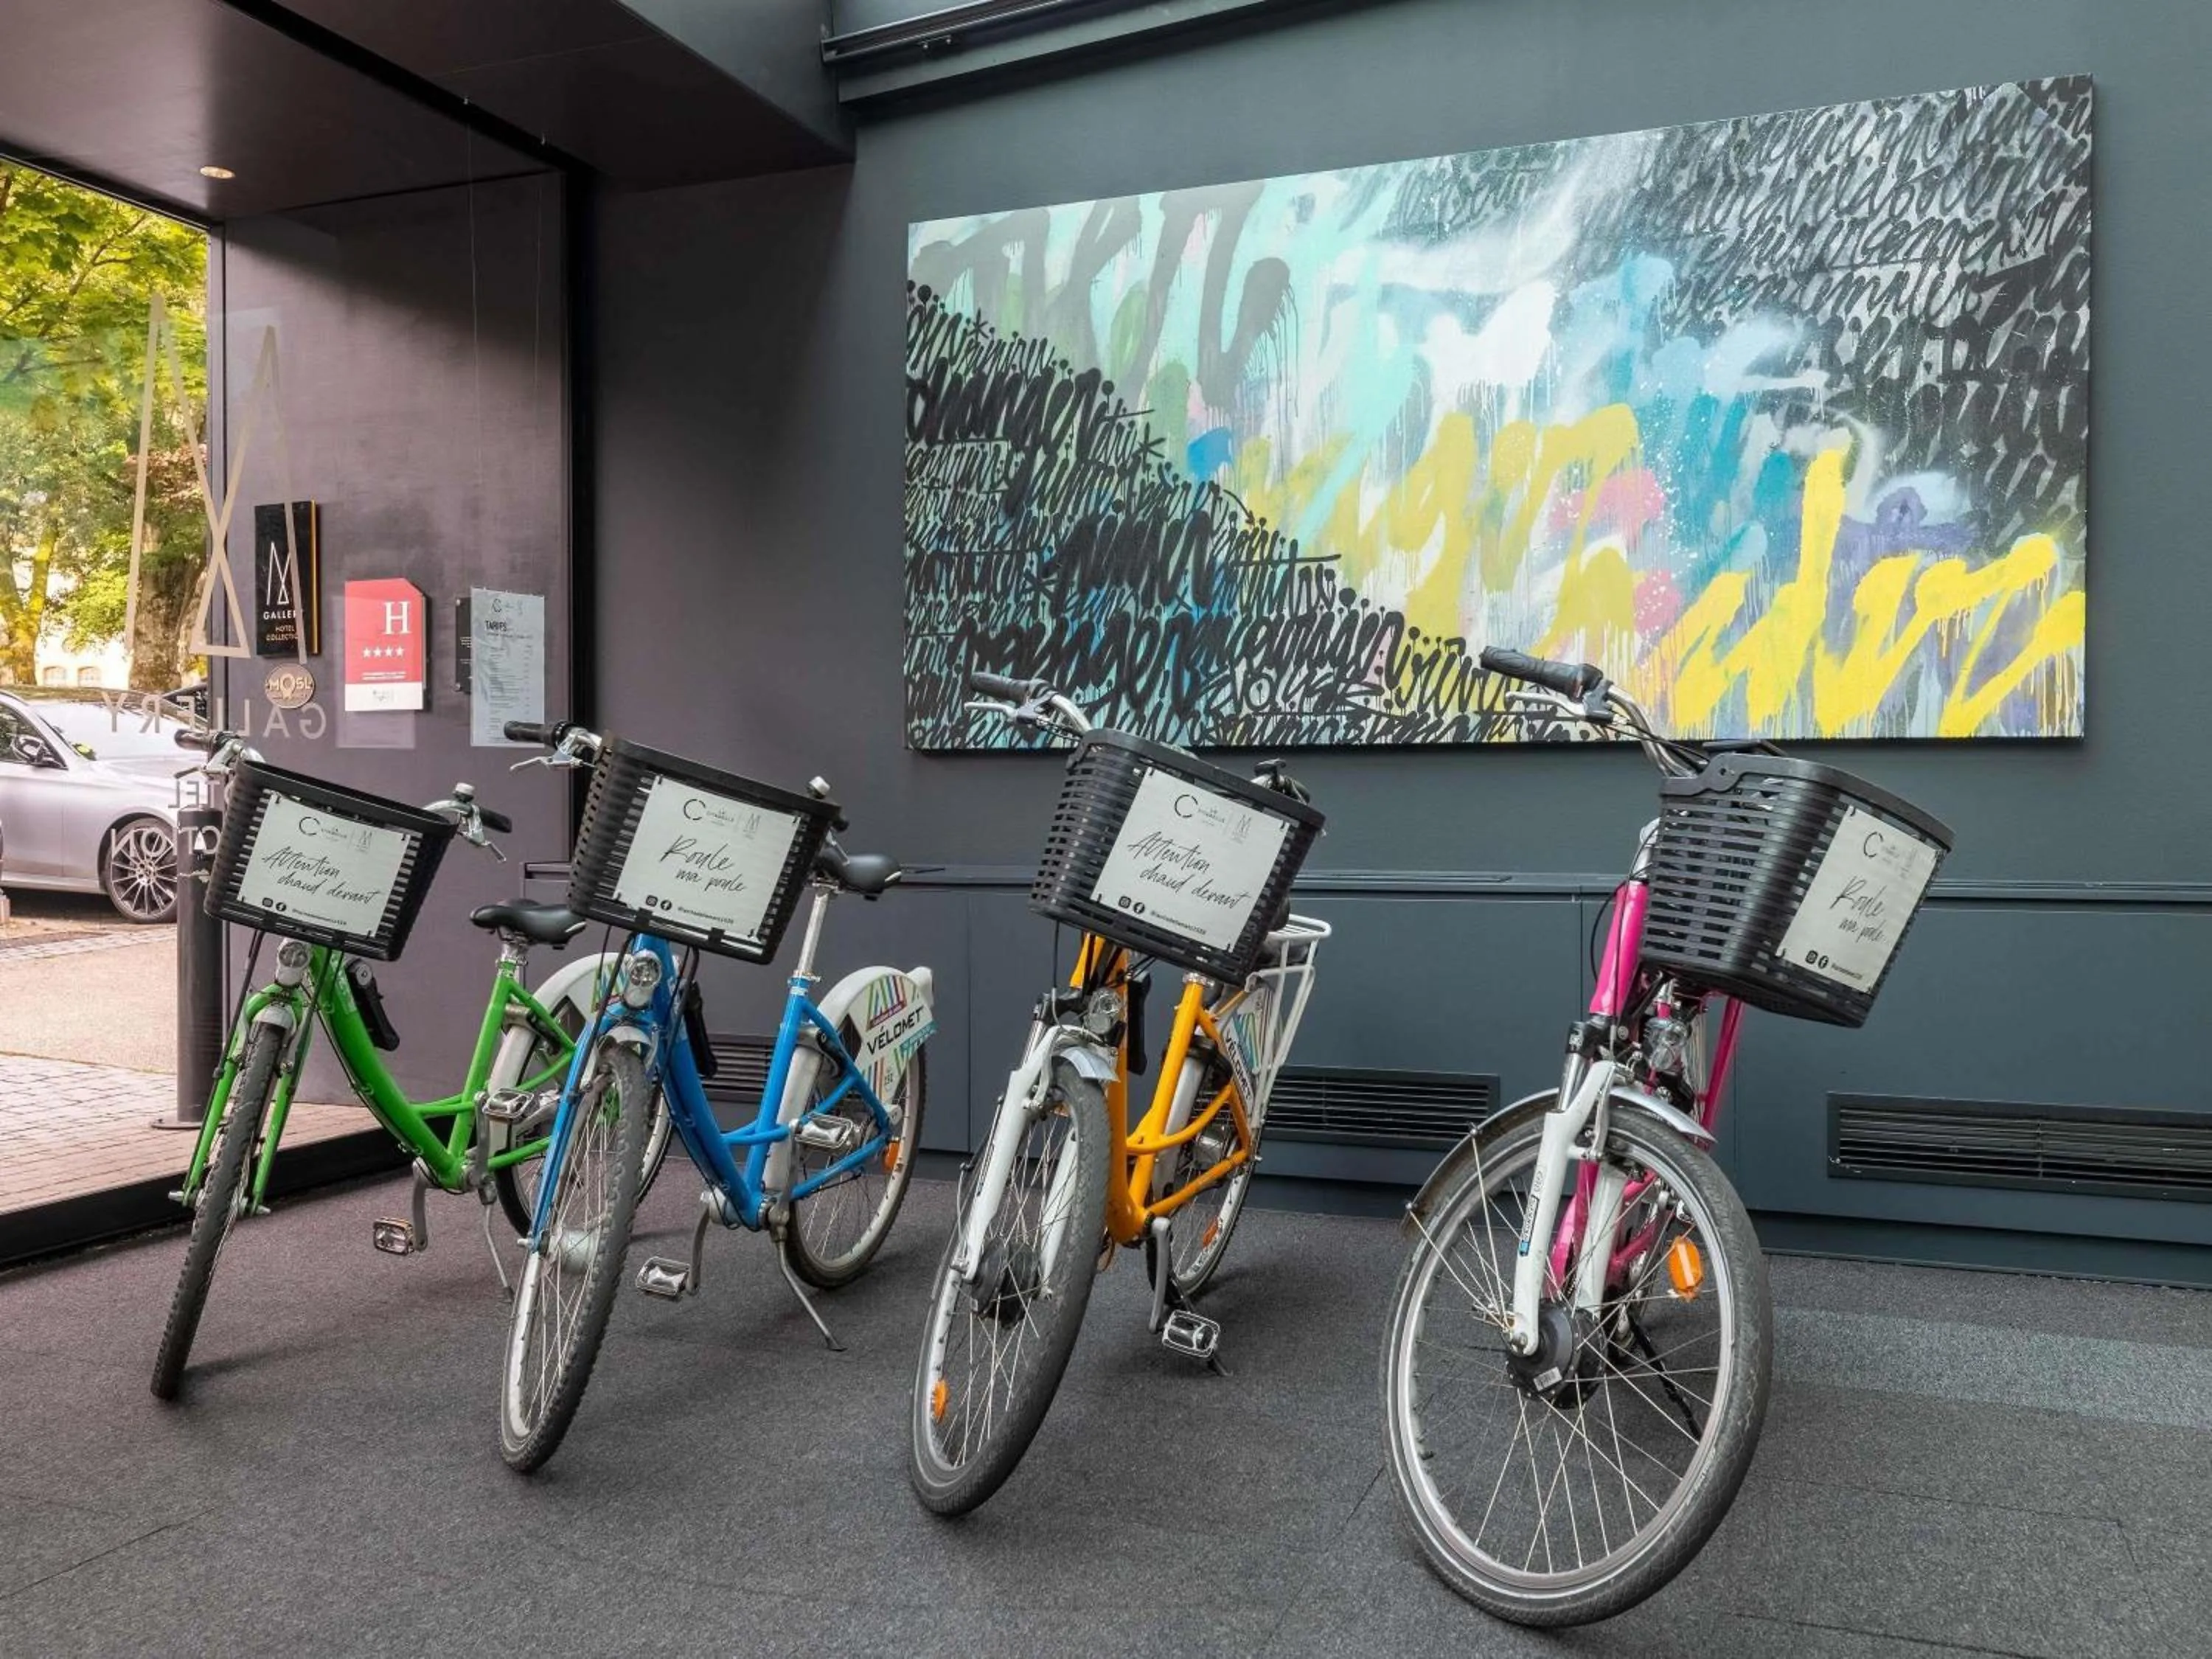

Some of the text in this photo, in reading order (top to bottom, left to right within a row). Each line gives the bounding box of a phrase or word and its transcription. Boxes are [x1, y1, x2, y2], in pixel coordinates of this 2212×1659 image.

[263, 609, 302, 620] GALLE
[383, 600, 412, 635] H
[262, 846, 342, 878] Attention
[1127, 831, 1211, 874] Attention
[1139, 863, 1252, 909] chaud devant
[866, 1004, 925, 1055] VÉLOMET
